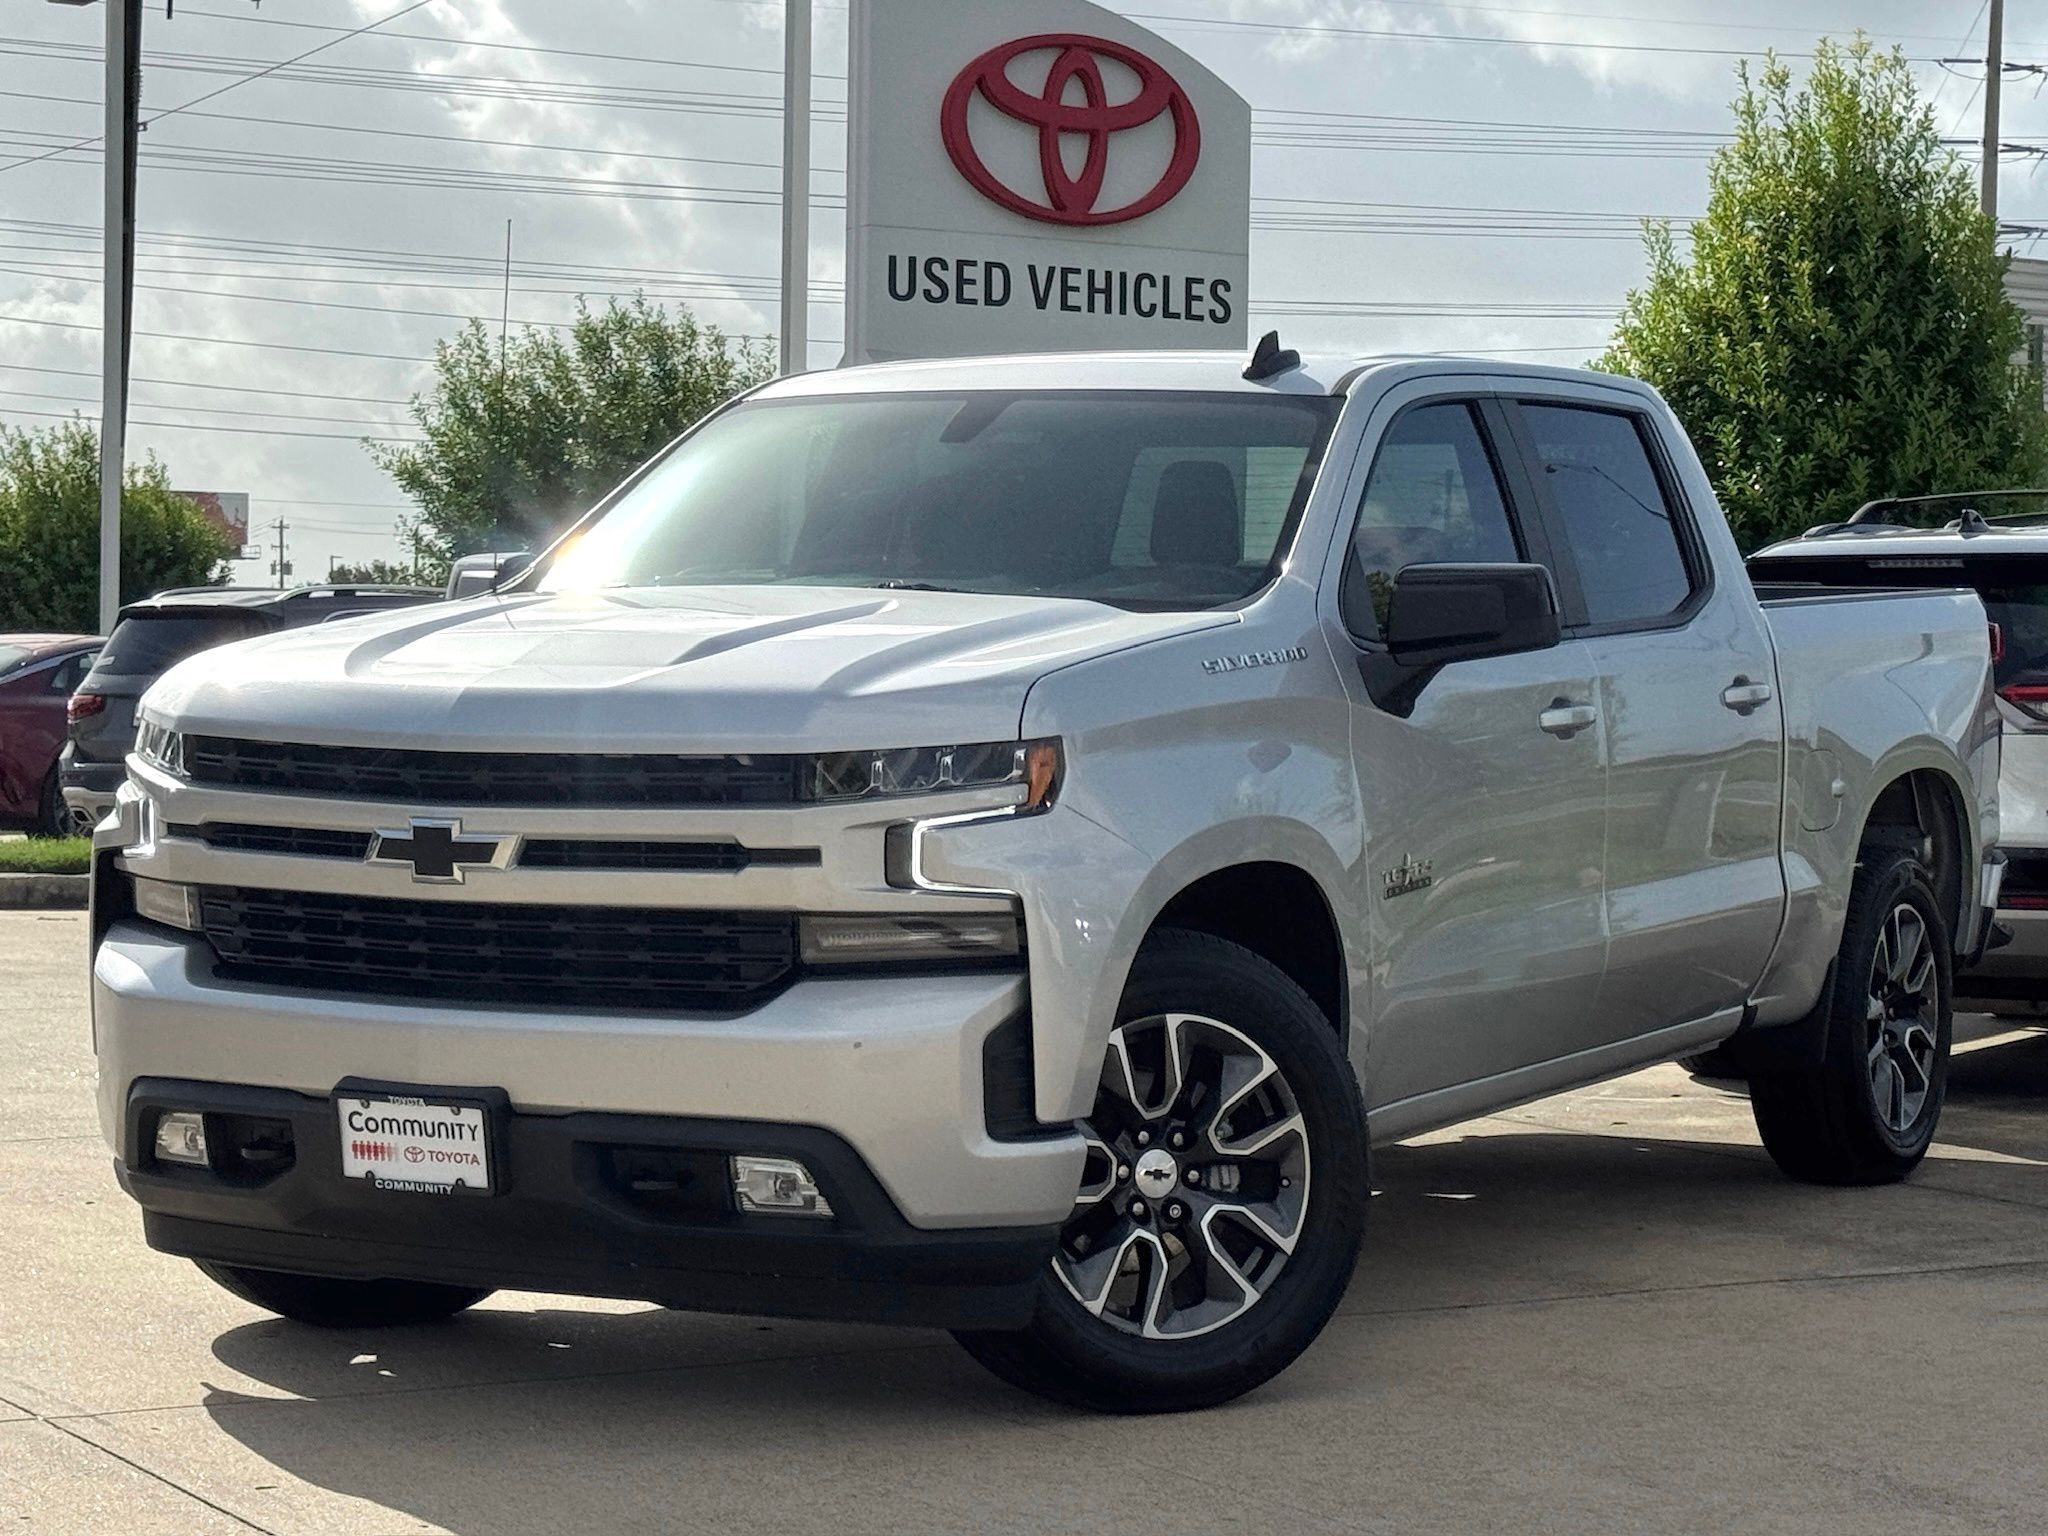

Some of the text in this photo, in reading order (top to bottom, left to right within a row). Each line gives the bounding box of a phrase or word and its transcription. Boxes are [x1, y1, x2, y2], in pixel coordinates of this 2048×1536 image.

[887, 254, 1233, 325] USED VEHICLES
[427, 1150, 481, 1166] TOYOTA
[374, 1178, 454, 1195] COMMUNITY
